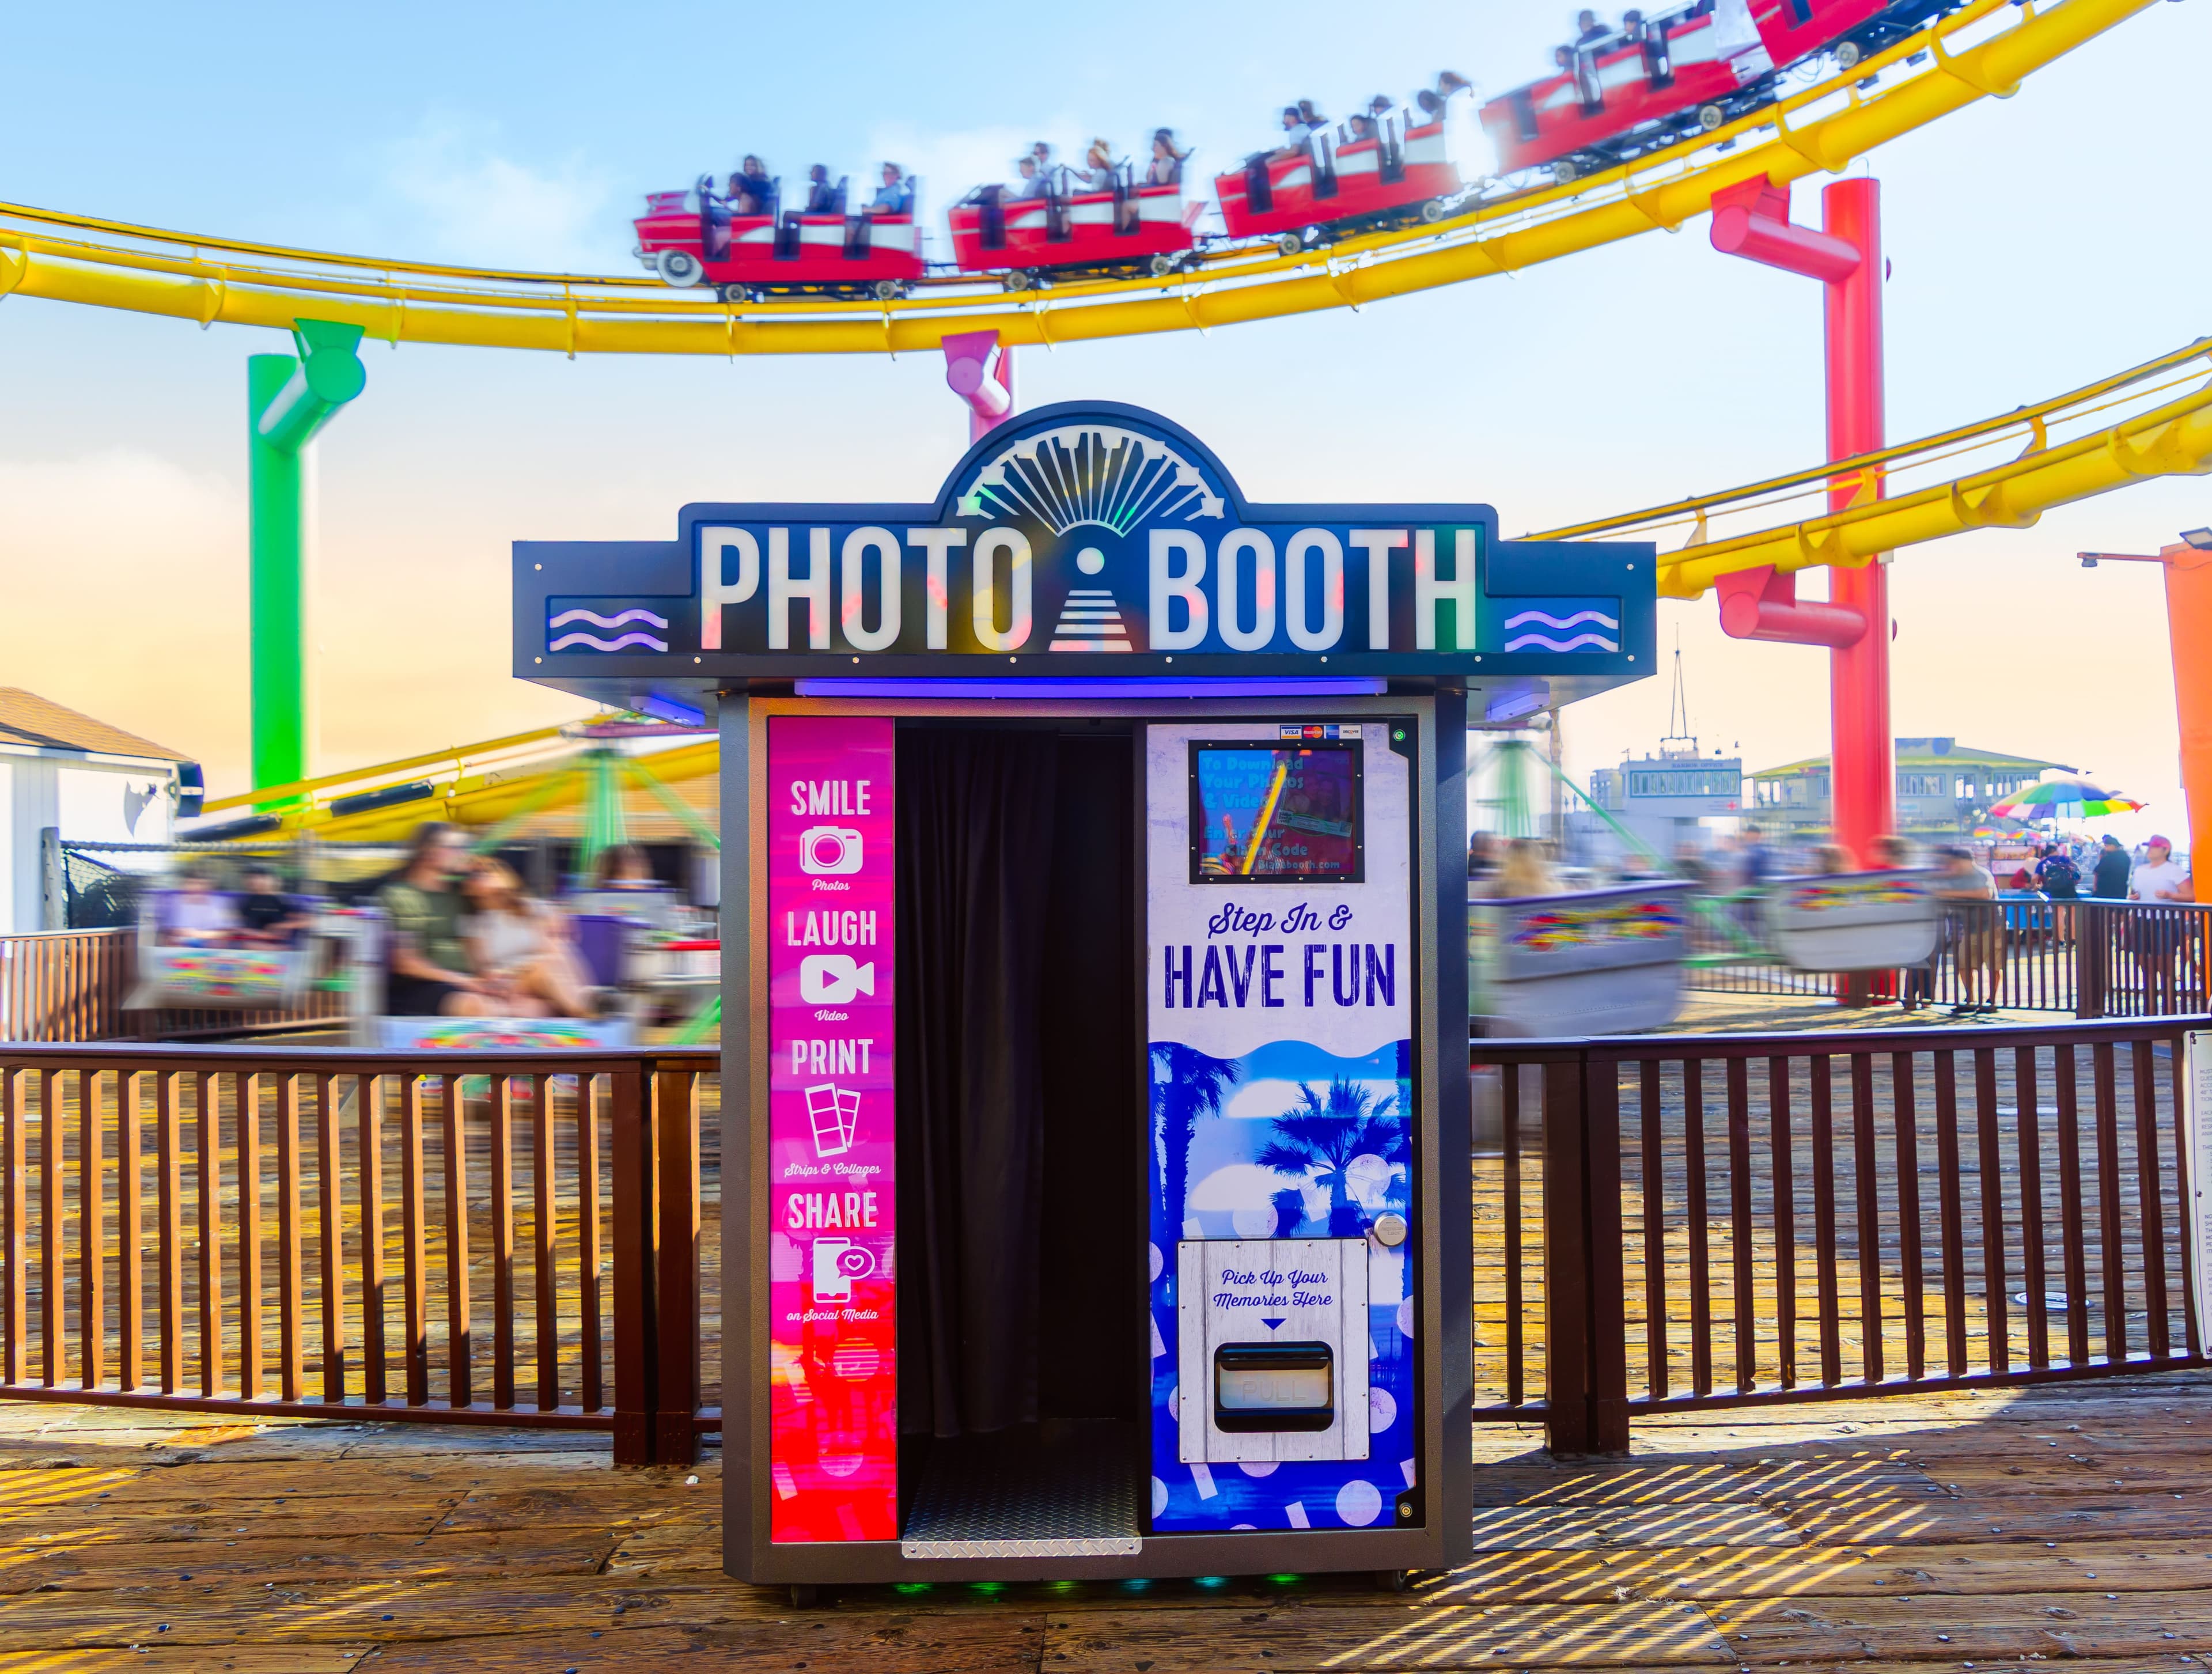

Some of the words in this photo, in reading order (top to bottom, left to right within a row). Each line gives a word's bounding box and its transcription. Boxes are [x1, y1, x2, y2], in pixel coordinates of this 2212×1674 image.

[701, 525, 1033, 652] PHOTO
[1149, 527, 1478, 652] BOOTH
[1202, 757, 1221, 770] To
[1203, 774, 1243, 789] Your
[1248, 774, 1304, 789] Phos
[791, 780, 871, 816] SMILE
[1203, 793, 1218, 809] &
[1271, 842, 1308, 857] Code
[812, 878, 851, 891] Photos
[787, 910, 877, 946] LAUGH
[1207, 902, 1277, 939] Step
[1281, 902, 1323, 934] In
[1328, 904, 1353, 931] &
[1164, 944, 1285, 1009] HAVE
[1304, 943, 1396, 1008] FUN
[814, 1009, 850, 1021] Video
[791, 1039, 874, 1074] PRINT
[784, 1162, 820, 1178] Strips
[821, 1163, 831, 1174] &
[834, 1162, 881, 1177] Collages
[788, 1192, 877, 1229] SHARE
[1222, 1269, 1256, 1285] Pick
[1259, 1270, 1284, 1287] Up
[1287, 1270, 1328, 1289] Your
[1213, 1293, 1290, 1310] Memories
[1292, 1291, 1333, 1308] Here
[786, 1312, 802, 1321] on
[802, 1308, 840, 1323] Social
[841, 1308, 878, 1321] Media
[1242, 1380, 1307, 1402] PULL
